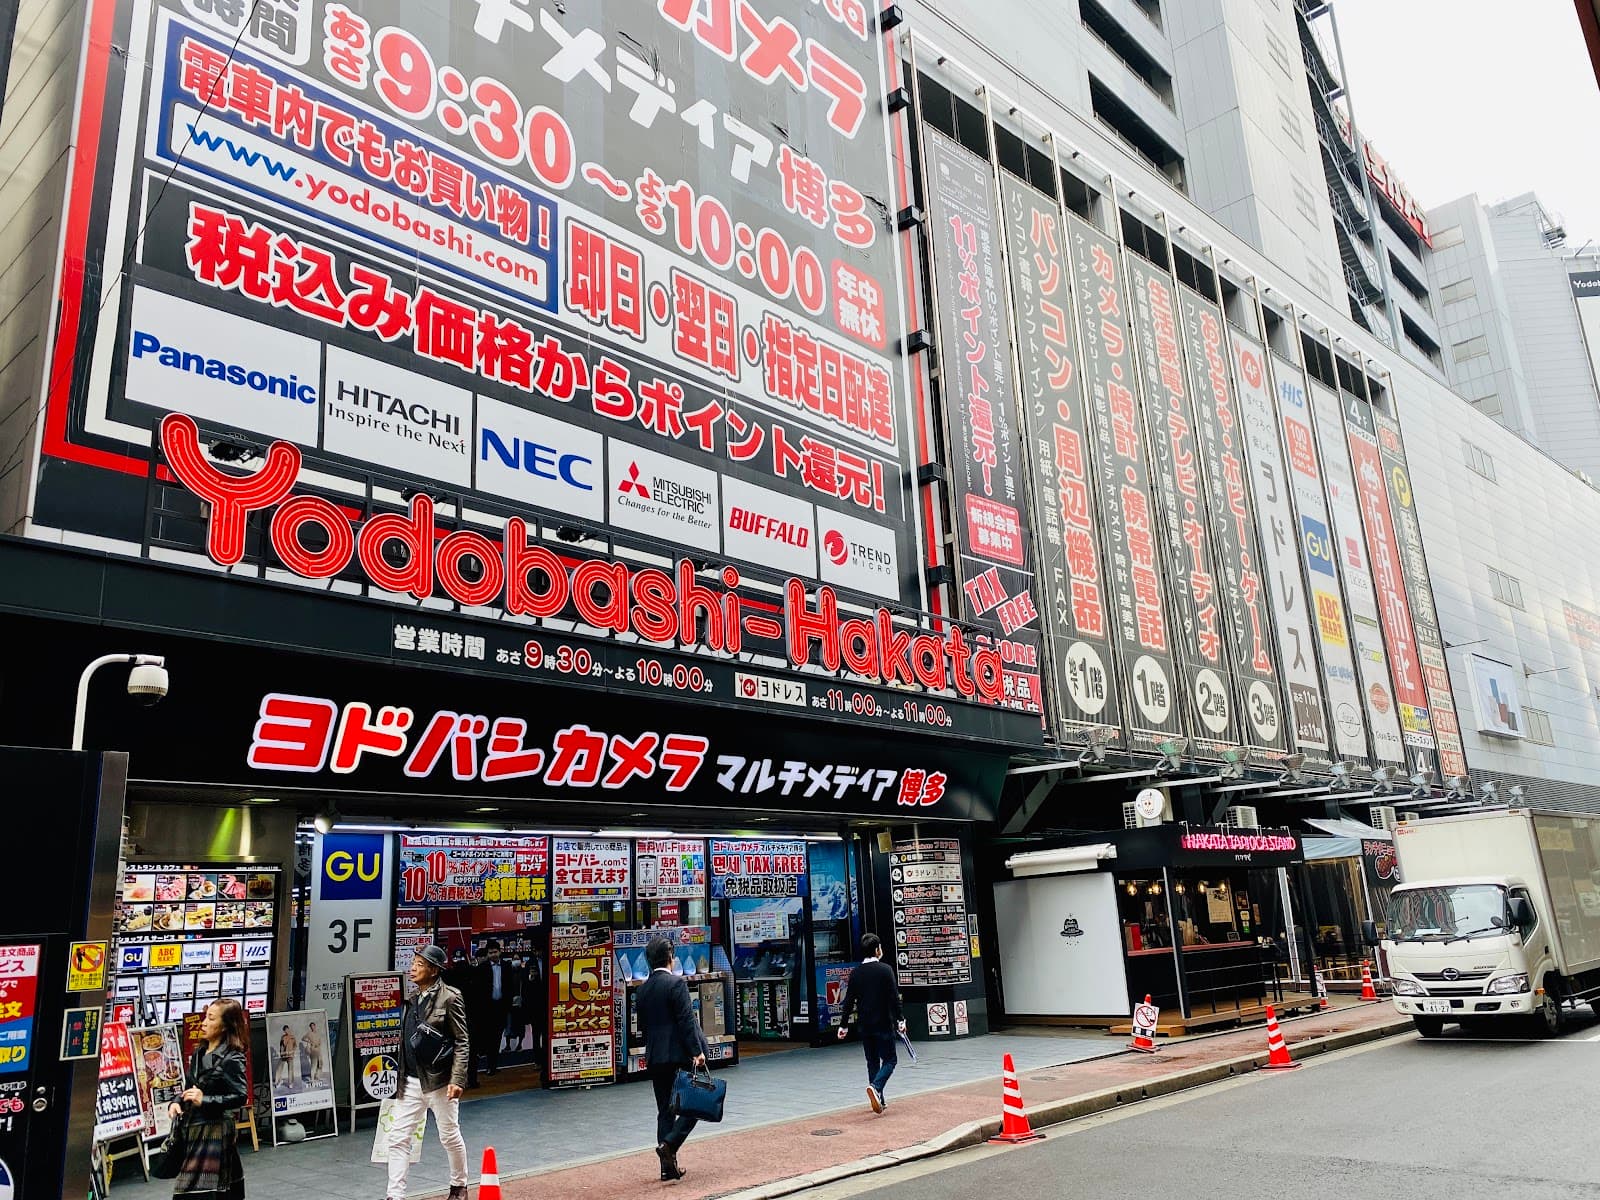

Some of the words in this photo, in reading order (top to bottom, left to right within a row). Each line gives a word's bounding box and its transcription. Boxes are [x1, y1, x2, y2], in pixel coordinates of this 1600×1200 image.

[178, 36, 551, 252] 電車内でもお買い物!
[325, 5, 369, 87] あさ
[374, 28, 577, 190] 9:30
[637, 168, 667, 235] よる
[669, 184, 826, 314] 10:00
[187, 123, 539, 286] www.yodobashi.com
[837, 266, 879, 307] 年中
[567, 220, 897, 444] 即日・翌日・指定日配達
[838, 297, 882, 342] 無休
[132, 331, 316, 405] Panasonic
[186, 200, 886, 514] 税込み価格からポイント還元!
[337, 380, 460, 436] HITACHI
[1280, 381, 1303, 409] HIS
[328, 402, 391, 437] Inspire
[396, 423, 424, 443] the
[429, 431, 466, 455] Next
[1029, 207, 1104, 637] パソコン・周辺機器
[1349, 399, 1368, 429] 4F
[1091, 243, 1167, 651] カメラ・時計・携帯電話
[1289, 422, 1307, 443] 100
[481, 427, 593, 491] NEC
[652, 476, 712, 505] MITSUBISHI
[652, 488, 705, 514] ELECTRIC
[617, 495, 655, 514] Changes
[656, 506, 671, 520] for
[672, 510, 686, 523] the
[687, 513, 712, 529] Better
[729, 507, 809, 549] BUFFALO
[970, 506, 1019, 537] 新規会員
[159, 412, 1005, 700] Yodobashi-Hakata
[850, 541, 891, 565] TREND
[977, 529, 1013, 551] 募集中
[1306, 531, 1330, 562] GU
[851, 557, 892, 575] MICRO
[1261, 460, 1307, 673] ヨドレス
[963, 566, 1009, 617] TAX
[1319, 595, 1340, 621] ABC
[996, 590, 1039, 637] FREE
[394, 624, 486, 661] 営業時間
[759, 677, 804, 704] ヨドレス
[1137, 668, 1167, 708] 1階
[1200, 681, 1227, 718] 2階
[1251, 692, 1276, 727] 3階
[248, 693, 709, 791] ヨドバシカメラ
[517, 853, 545, 863] ヨドバシ
[1181, 833, 1228, 850] HAKATA
[325, 850, 381, 882] GU
[426, 850, 447, 884] 10
[520, 863, 542, 872] カメラ
[555, 868, 629, 884] 全て買えます
[659, 868, 680, 877] スマホ
[661, 857, 677, 868] 店内
[713, 855, 740, 875] 면세
[744, 855, 773, 875] TAX
[773, 855, 805, 875] FREE
[403, 867, 426, 902] 10
[484, 876, 546, 902] 総額表示
[725, 876, 797, 896] 免税品取扱店
[158, 948, 175, 956] ABC
[327, 918, 373, 954] 3F
[124, 952, 142, 963] GU
[552, 957, 599, 1002] 15
[552, 1002, 611, 1017] ポイントで
[370, 1070, 396, 1087] 24h
[372, 1086, 394, 1096] OPEN
[275, 1100, 287, 1109] GU
